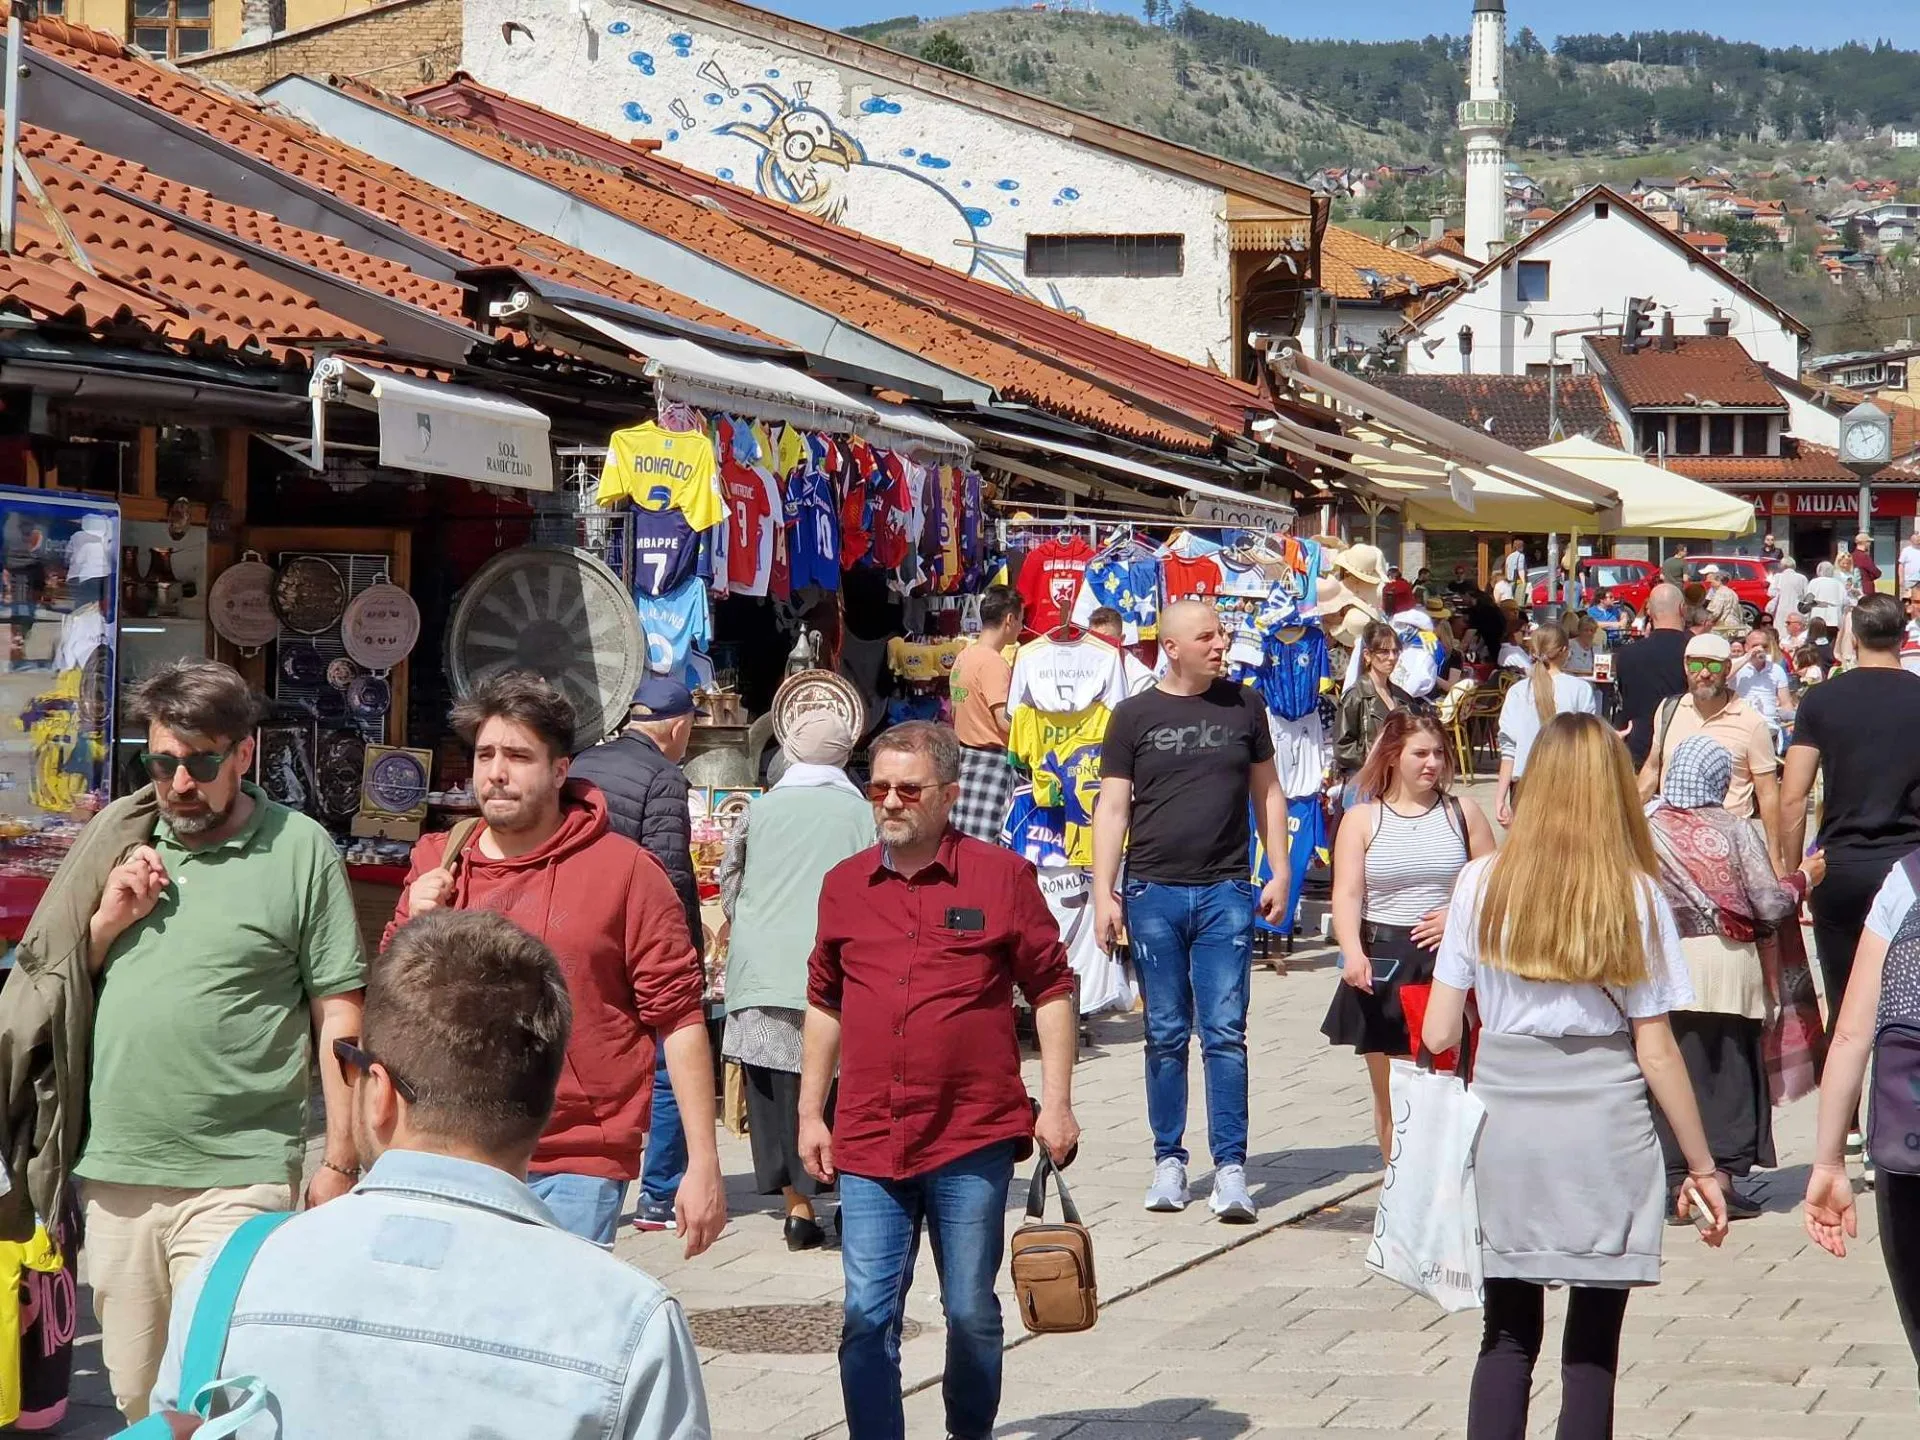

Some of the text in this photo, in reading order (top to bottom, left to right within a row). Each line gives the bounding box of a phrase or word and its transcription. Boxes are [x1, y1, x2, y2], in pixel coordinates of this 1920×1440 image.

[634, 456, 693, 481] RONALDO
[1796, 492, 1879, 513] MUJANĆ
[736, 501, 747, 548] 9
[643, 553, 668, 596] 7
[1026, 824, 1066, 848] ZIDA
